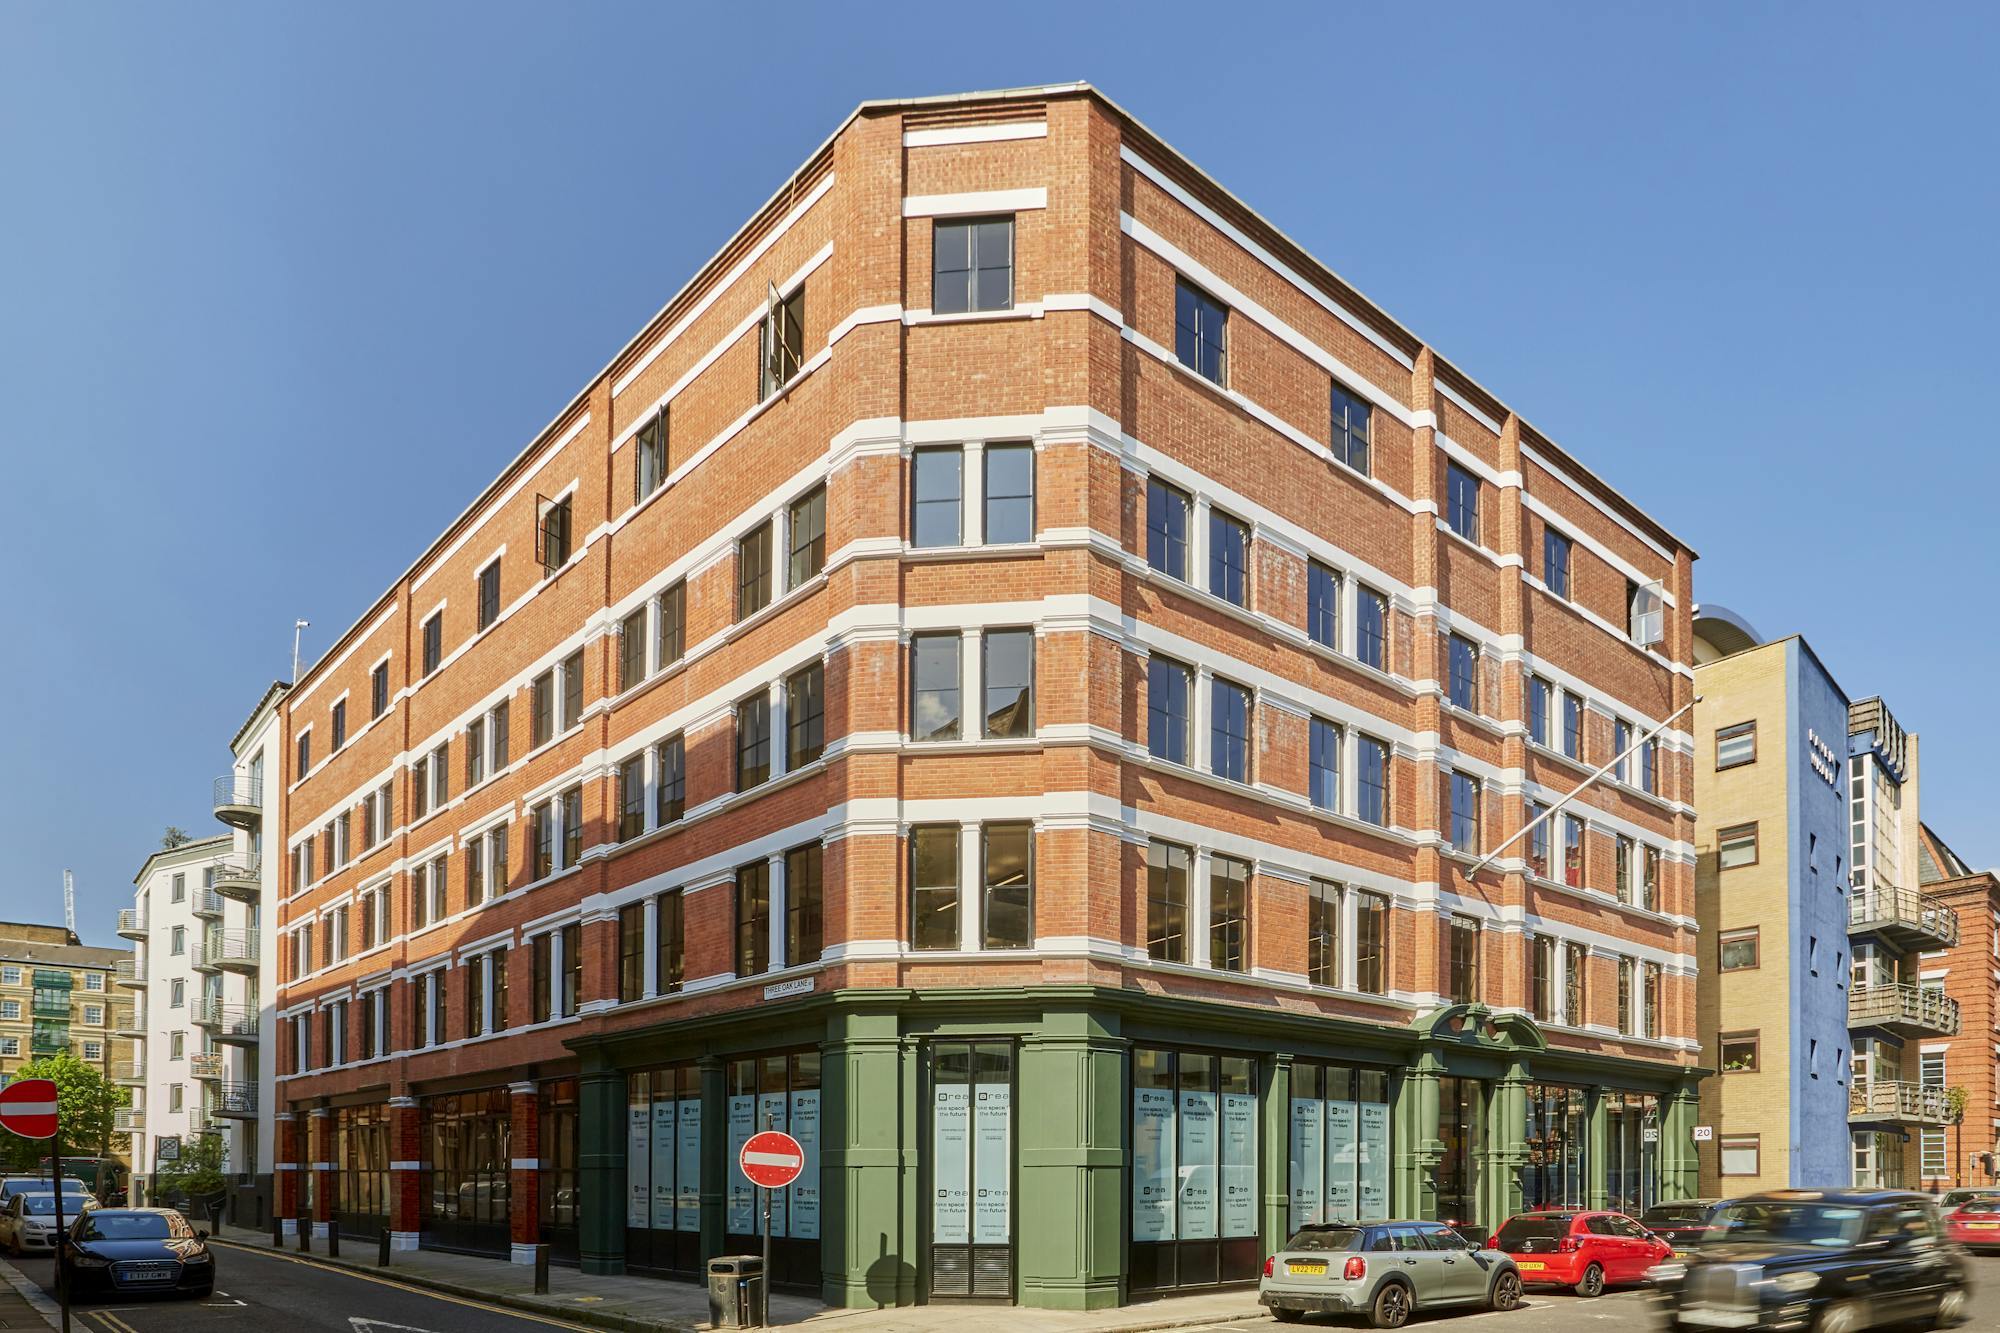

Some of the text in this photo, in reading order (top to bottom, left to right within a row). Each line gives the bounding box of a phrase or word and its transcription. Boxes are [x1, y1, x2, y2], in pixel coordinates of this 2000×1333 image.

[765, 985, 781, 995] THREE
[794, 979, 808, 988] LANE
[1697, 1129, 1710, 1137] 20
